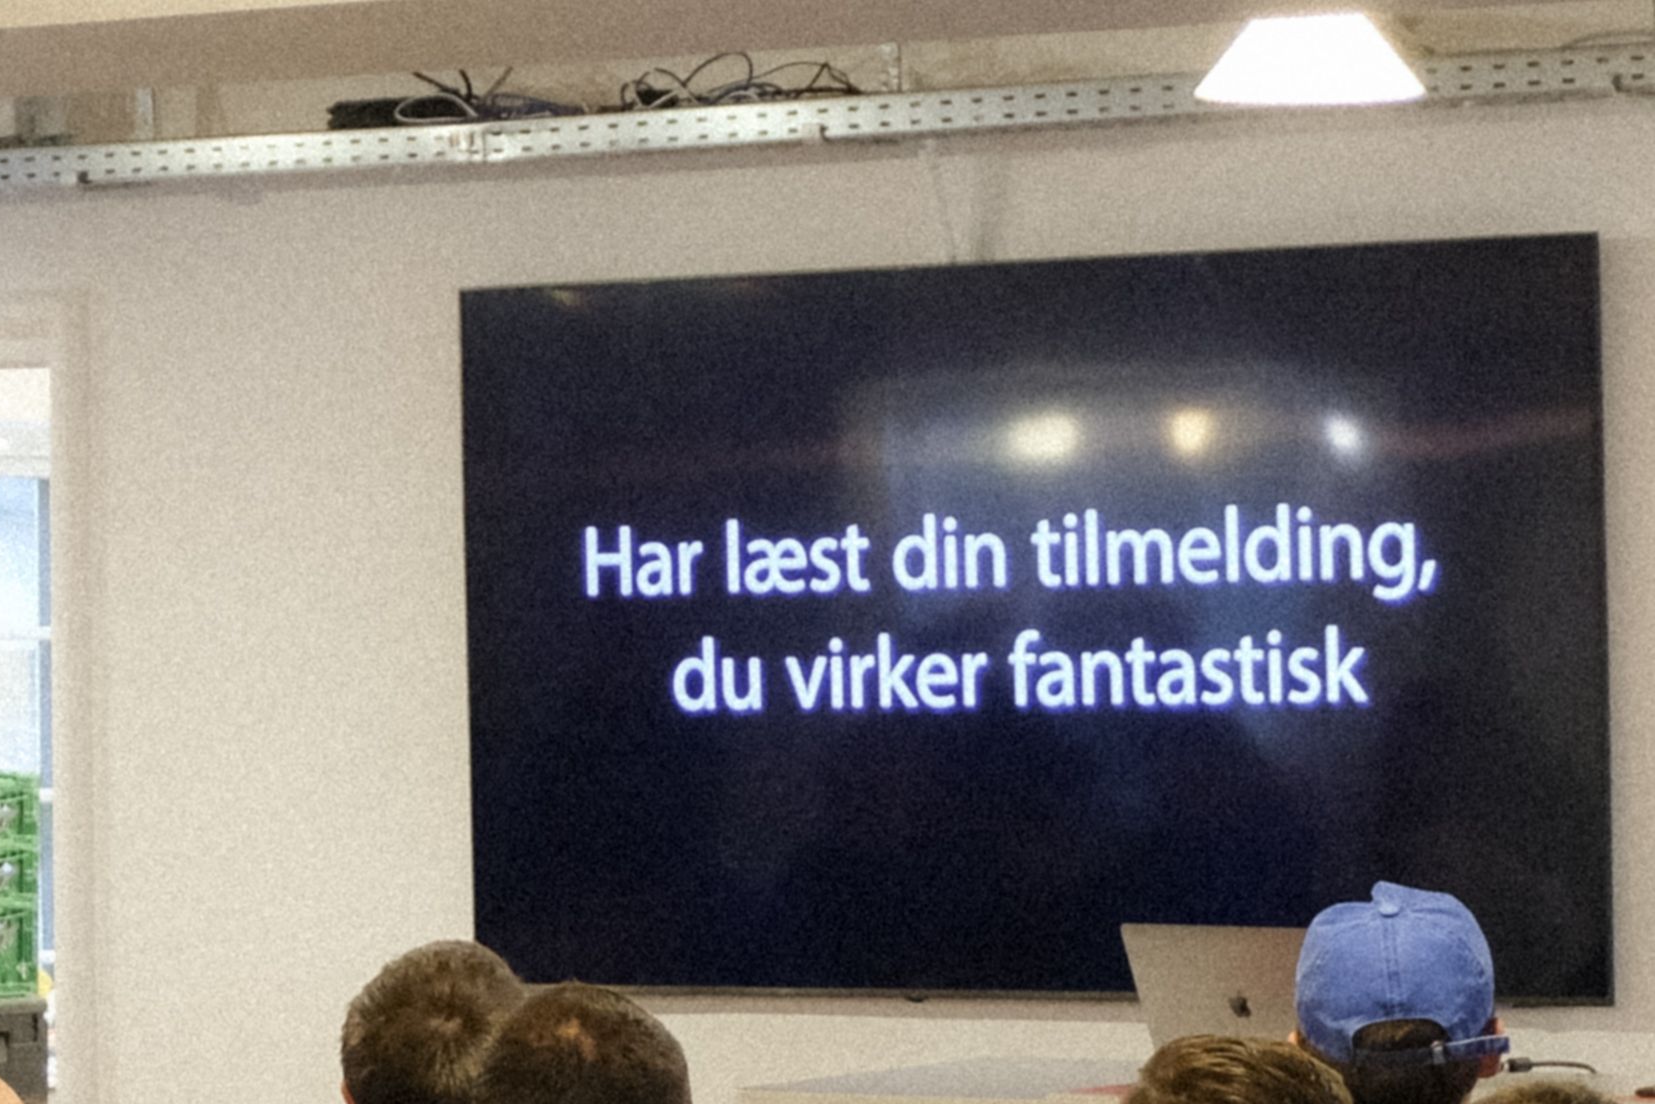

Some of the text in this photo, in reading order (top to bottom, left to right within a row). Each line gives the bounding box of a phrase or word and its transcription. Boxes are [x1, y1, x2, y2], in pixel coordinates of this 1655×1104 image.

[584, 501, 1437, 602] Har læst din tilmelding,
[672, 623, 1370, 713] du virker fantastisk
